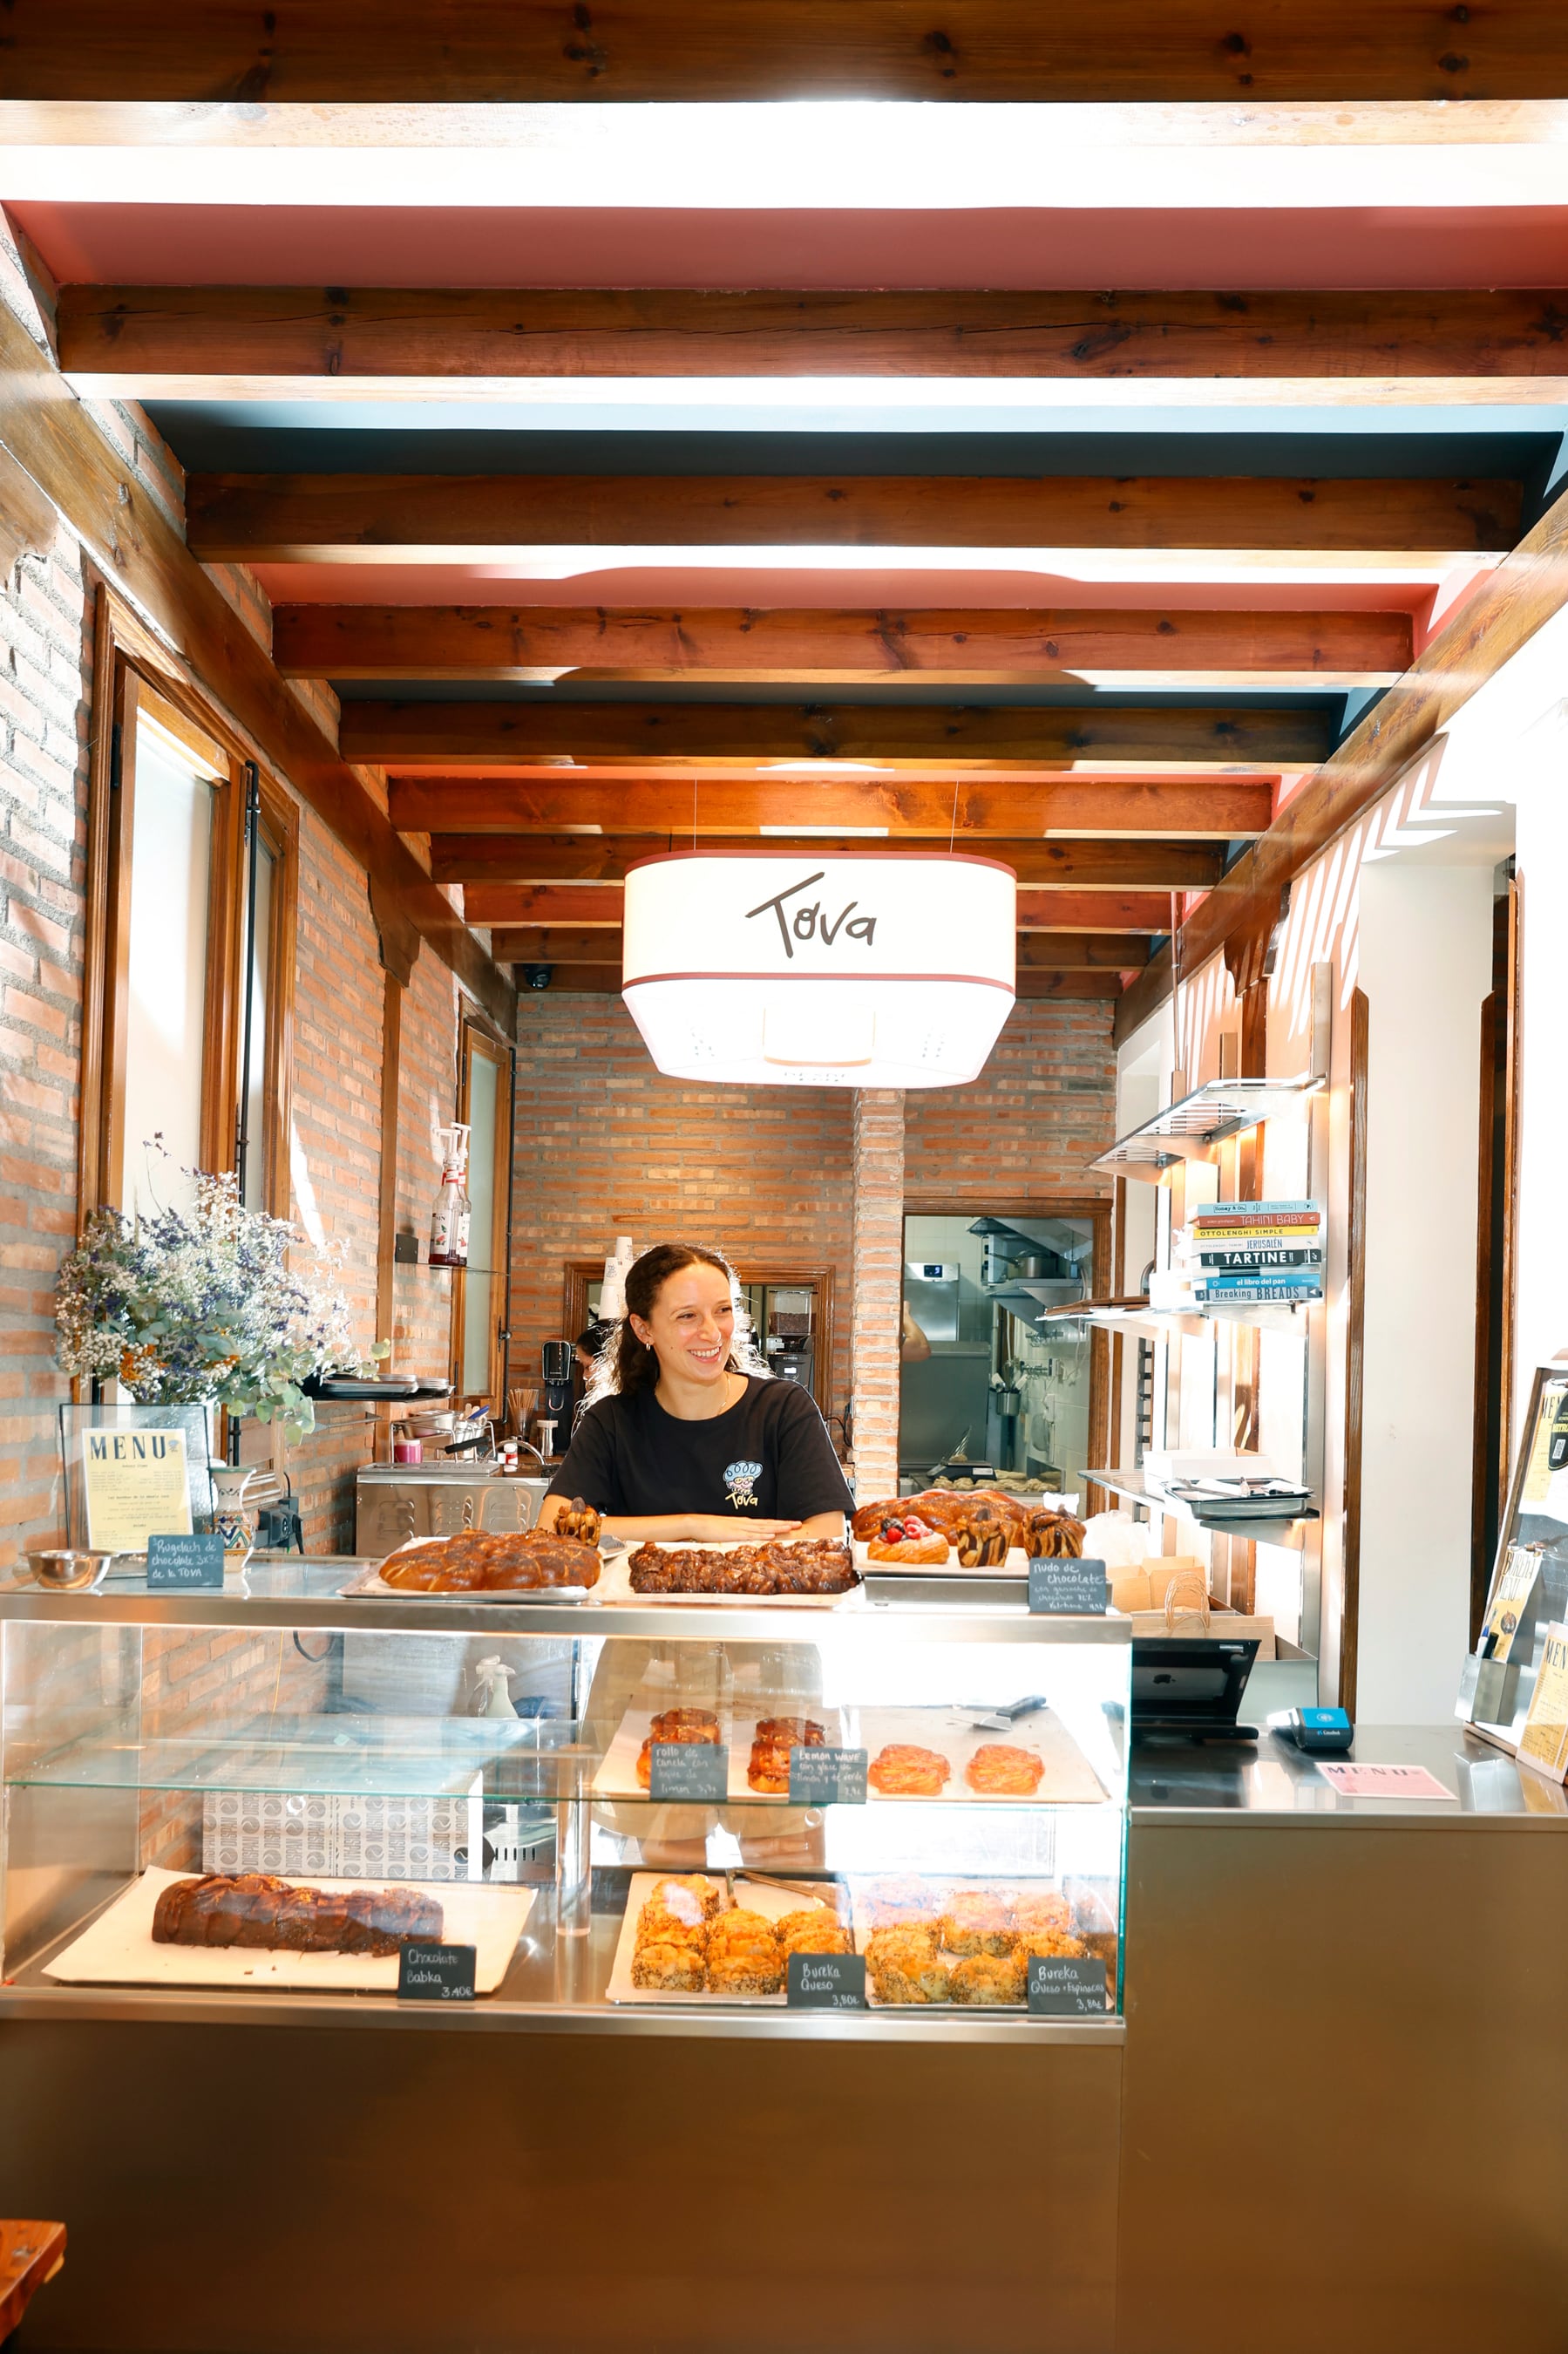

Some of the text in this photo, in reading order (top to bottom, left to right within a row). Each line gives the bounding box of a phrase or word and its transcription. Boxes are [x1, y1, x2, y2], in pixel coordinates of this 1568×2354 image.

[744, 871, 878, 959] Tova
[1240, 1214, 1273, 1226] TAHINI
[1276, 1213, 1304, 1225] BABY
[1246, 1237, 1283, 1249] JERUSALÉN
[1224, 1251, 1287, 1264] TARTINE
[1215, 1287, 1300, 1300] Breaking BREADS
[90, 1436, 166, 1460] MENU
[725, 1491, 758, 1510] Tova
[1544, 1639, 1568, 1671] MEN
[221, 1817, 238, 1847] DISPAN
[264, 1819, 282, 1848] DISPAN
[308, 1820, 325, 1850] DISPAN
[411, 1814, 428, 1844] DISPAN
[241, 1836, 259, 1866] DISPAN
[286, 1838, 302, 1868] DISPAN
[343, 1832, 362, 1861] DISPAN
[388, 1833, 406, 1861] DISPAN
[433, 1834, 451, 1862] DISPAN
[406, 1970, 443, 1983] Babka
[800, 1978, 833, 1990] Queso
